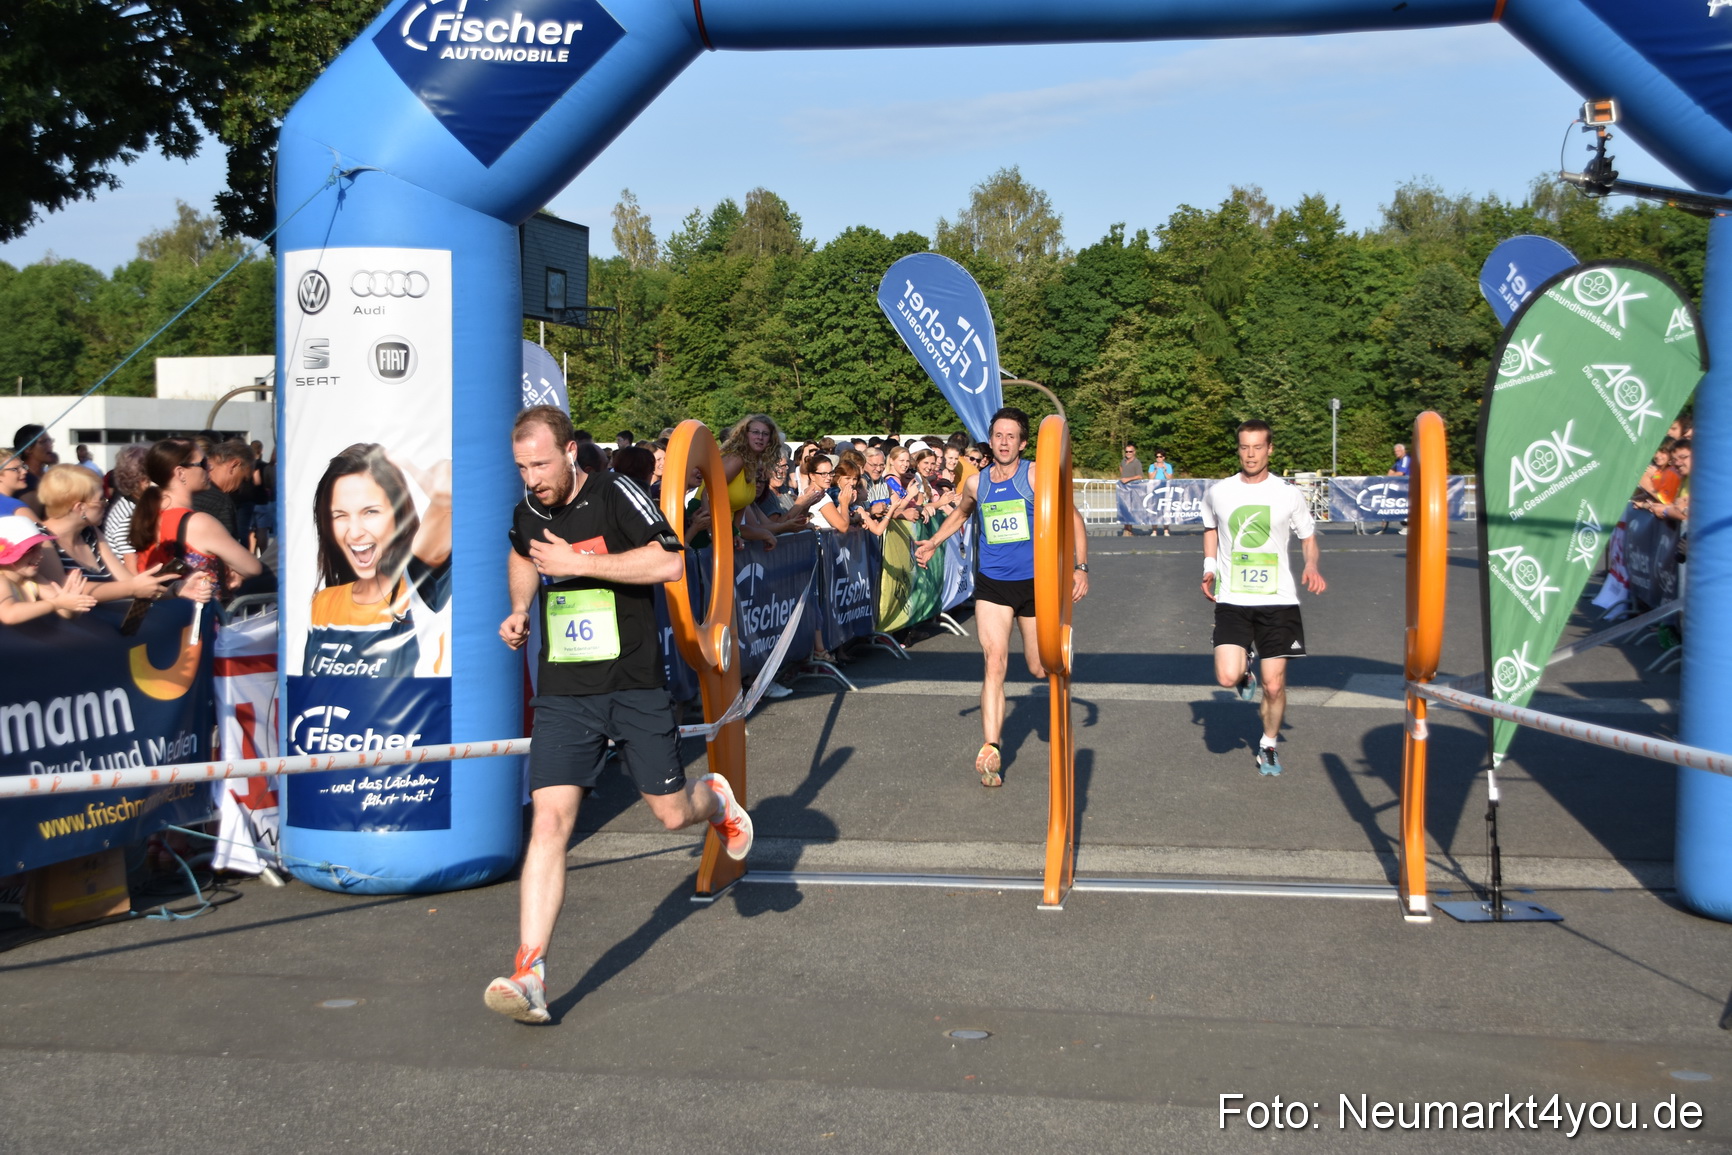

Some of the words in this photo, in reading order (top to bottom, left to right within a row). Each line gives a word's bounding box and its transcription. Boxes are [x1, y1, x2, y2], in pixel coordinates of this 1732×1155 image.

[429, 13, 583, 45] Fischer
[440, 47, 569, 63] AUTOMOBILE
[353, 306, 386, 315] Audi
[380, 350, 407, 370] FIAT
[296, 376, 340, 386] SEAT
[1582, 365, 1593, 379] Die
[1591, 364, 1663, 437] AOK
[1509, 419, 1593, 508] AOK
[1509, 507, 1525, 521] Die
[1523, 460, 1600, 511] Gesundheitskasse.
[992, 517, 1018, 532] 648
[1570, 504, 1602, 571] AOK
[1240, 569, 1268, 583] 125
[1488, 546, 1560, 615] AOK
[741, 593, 796, 637] Fischer
[565, 619, 594, 642] 46
[307, 727, 421, 751] Fischer
[101, 740, 145, 772] und
[148, 733, 197, 766] Medien
[358, 777, 382, 790] das
[403, 788, 435, 803] mit!
